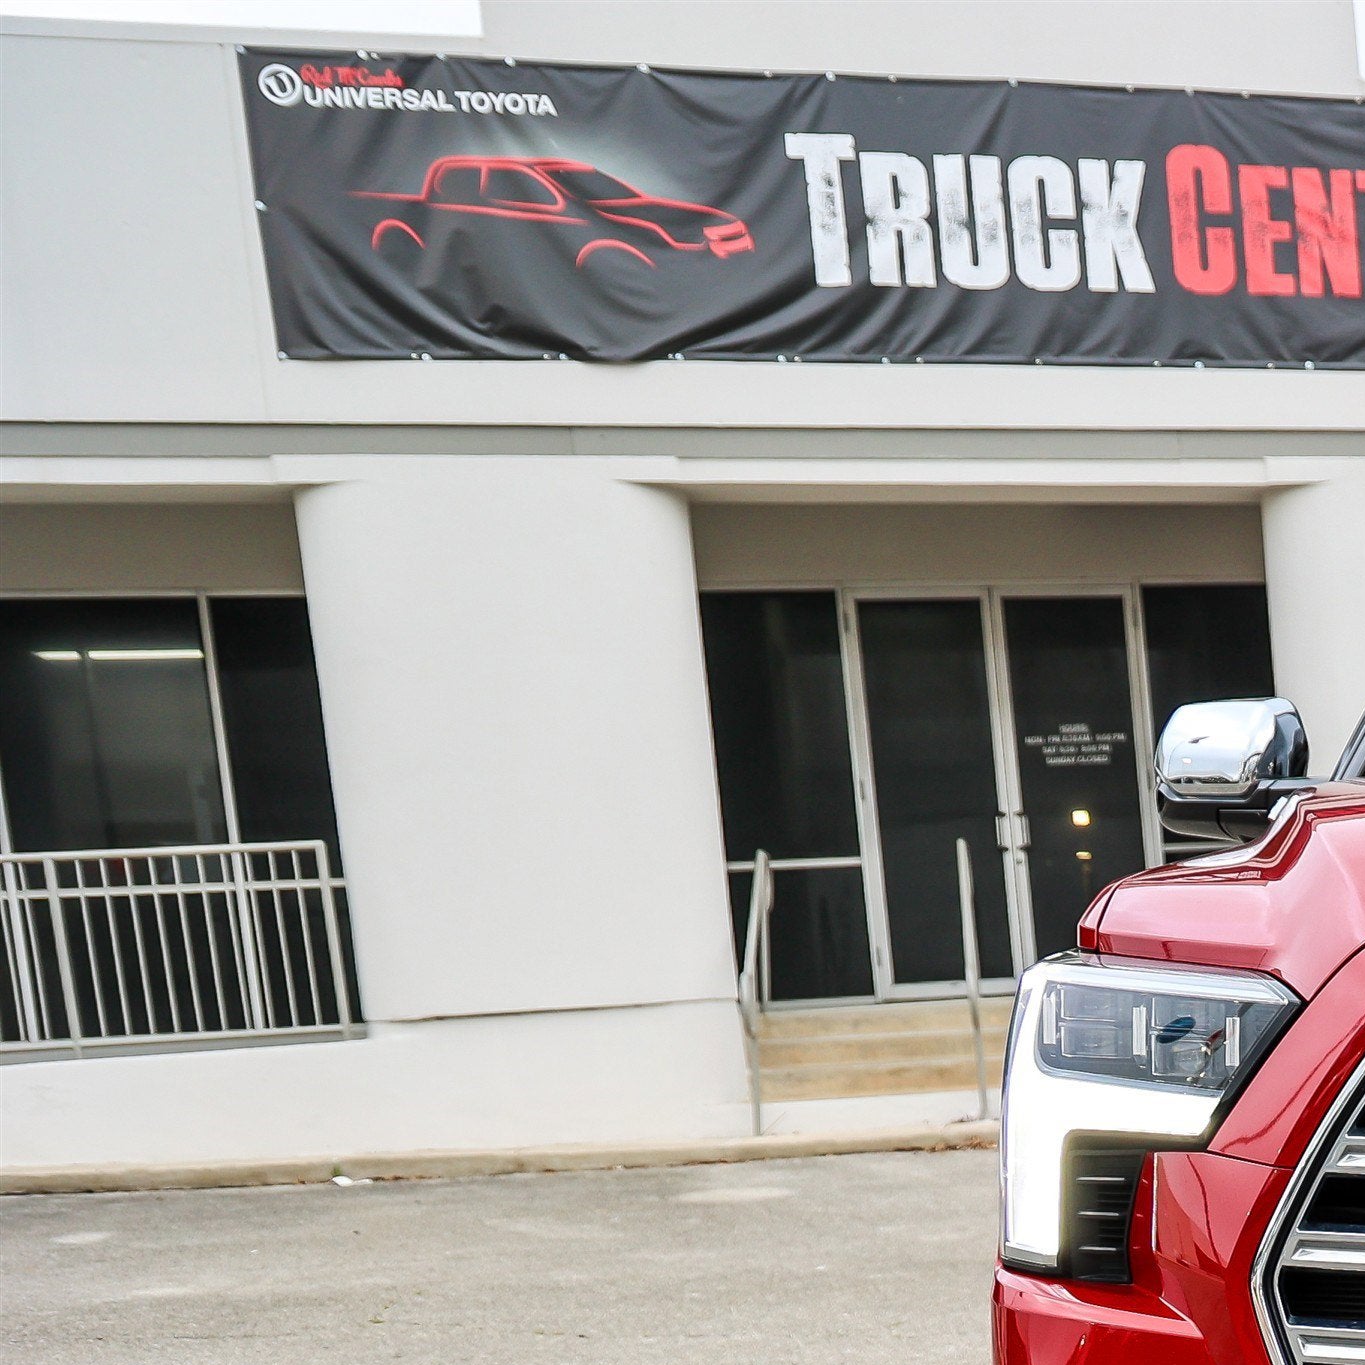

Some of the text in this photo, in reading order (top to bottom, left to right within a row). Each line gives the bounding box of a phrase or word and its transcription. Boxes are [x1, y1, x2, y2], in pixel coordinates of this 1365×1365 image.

[302, 84, 559, 118] UNIVERSAL TOYOTA
[783, 132, 1157, 295] TRUCK
